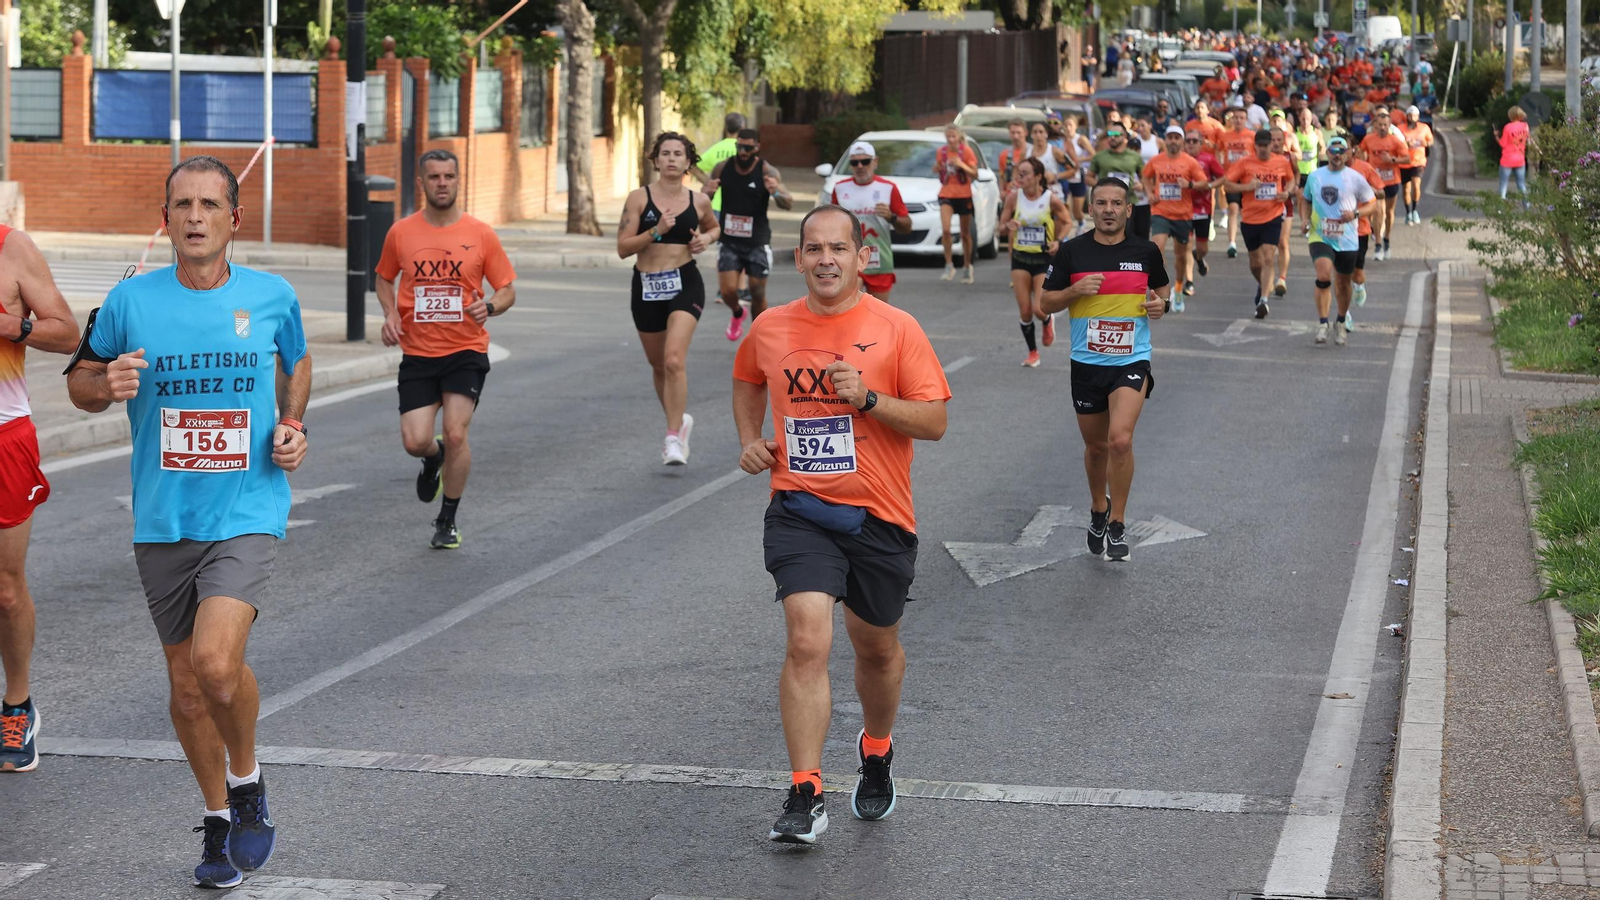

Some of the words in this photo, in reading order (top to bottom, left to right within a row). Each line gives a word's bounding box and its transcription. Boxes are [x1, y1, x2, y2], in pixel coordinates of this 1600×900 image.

[413, 260, 464, 277] XXIX
[1119, 262, 1143, 271] 226ERS
[649, 280, 675, 291] 1083
[425, 299, 450, 310] 228
[1098, 332, 1124, 344] 547
[154, 352, 258, 372] ATLETISMO
[155, 378, 223, 396] XEREZ
[233, 377, 256, 392] CD
[790, 396, 813, 404] MEDIA
[183, 431, 227, 451] 156
[797, 437, 835, 456] 594
